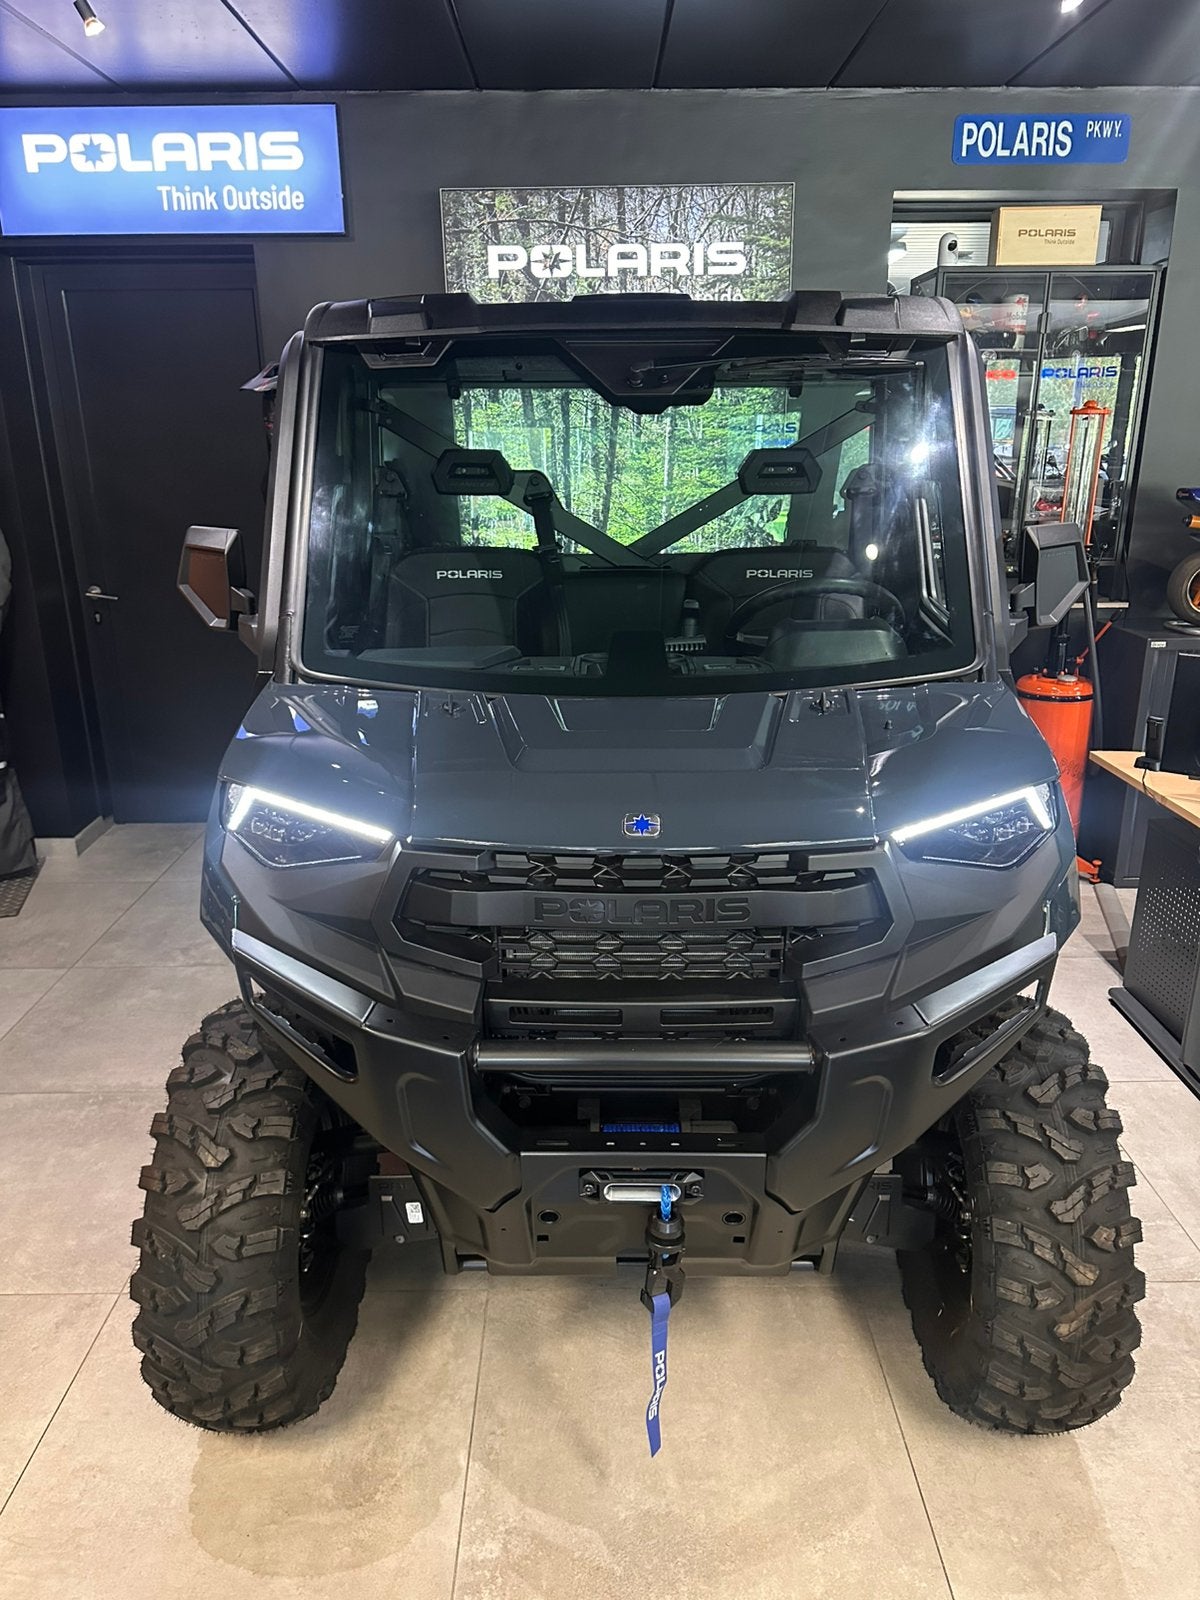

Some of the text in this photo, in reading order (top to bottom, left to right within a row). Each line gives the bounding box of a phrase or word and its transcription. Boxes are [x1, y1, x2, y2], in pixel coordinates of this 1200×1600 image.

[21, 131, 304, 173] POLARIS
[961, 120, 1123, 158] POLARIS PKWY.
[156, 184, 305, 211] Think Outside
[1018, 229, 1076, 237] POLARIS
[487, 241, 747, 279] POLARIS
[1041, 366, 1117, 379] POLARIS
[436, 570, 503, 580] POLARIS
[746, 569, 814, 578] POLARIS
[534, 896, 751, 924] POLARIS
